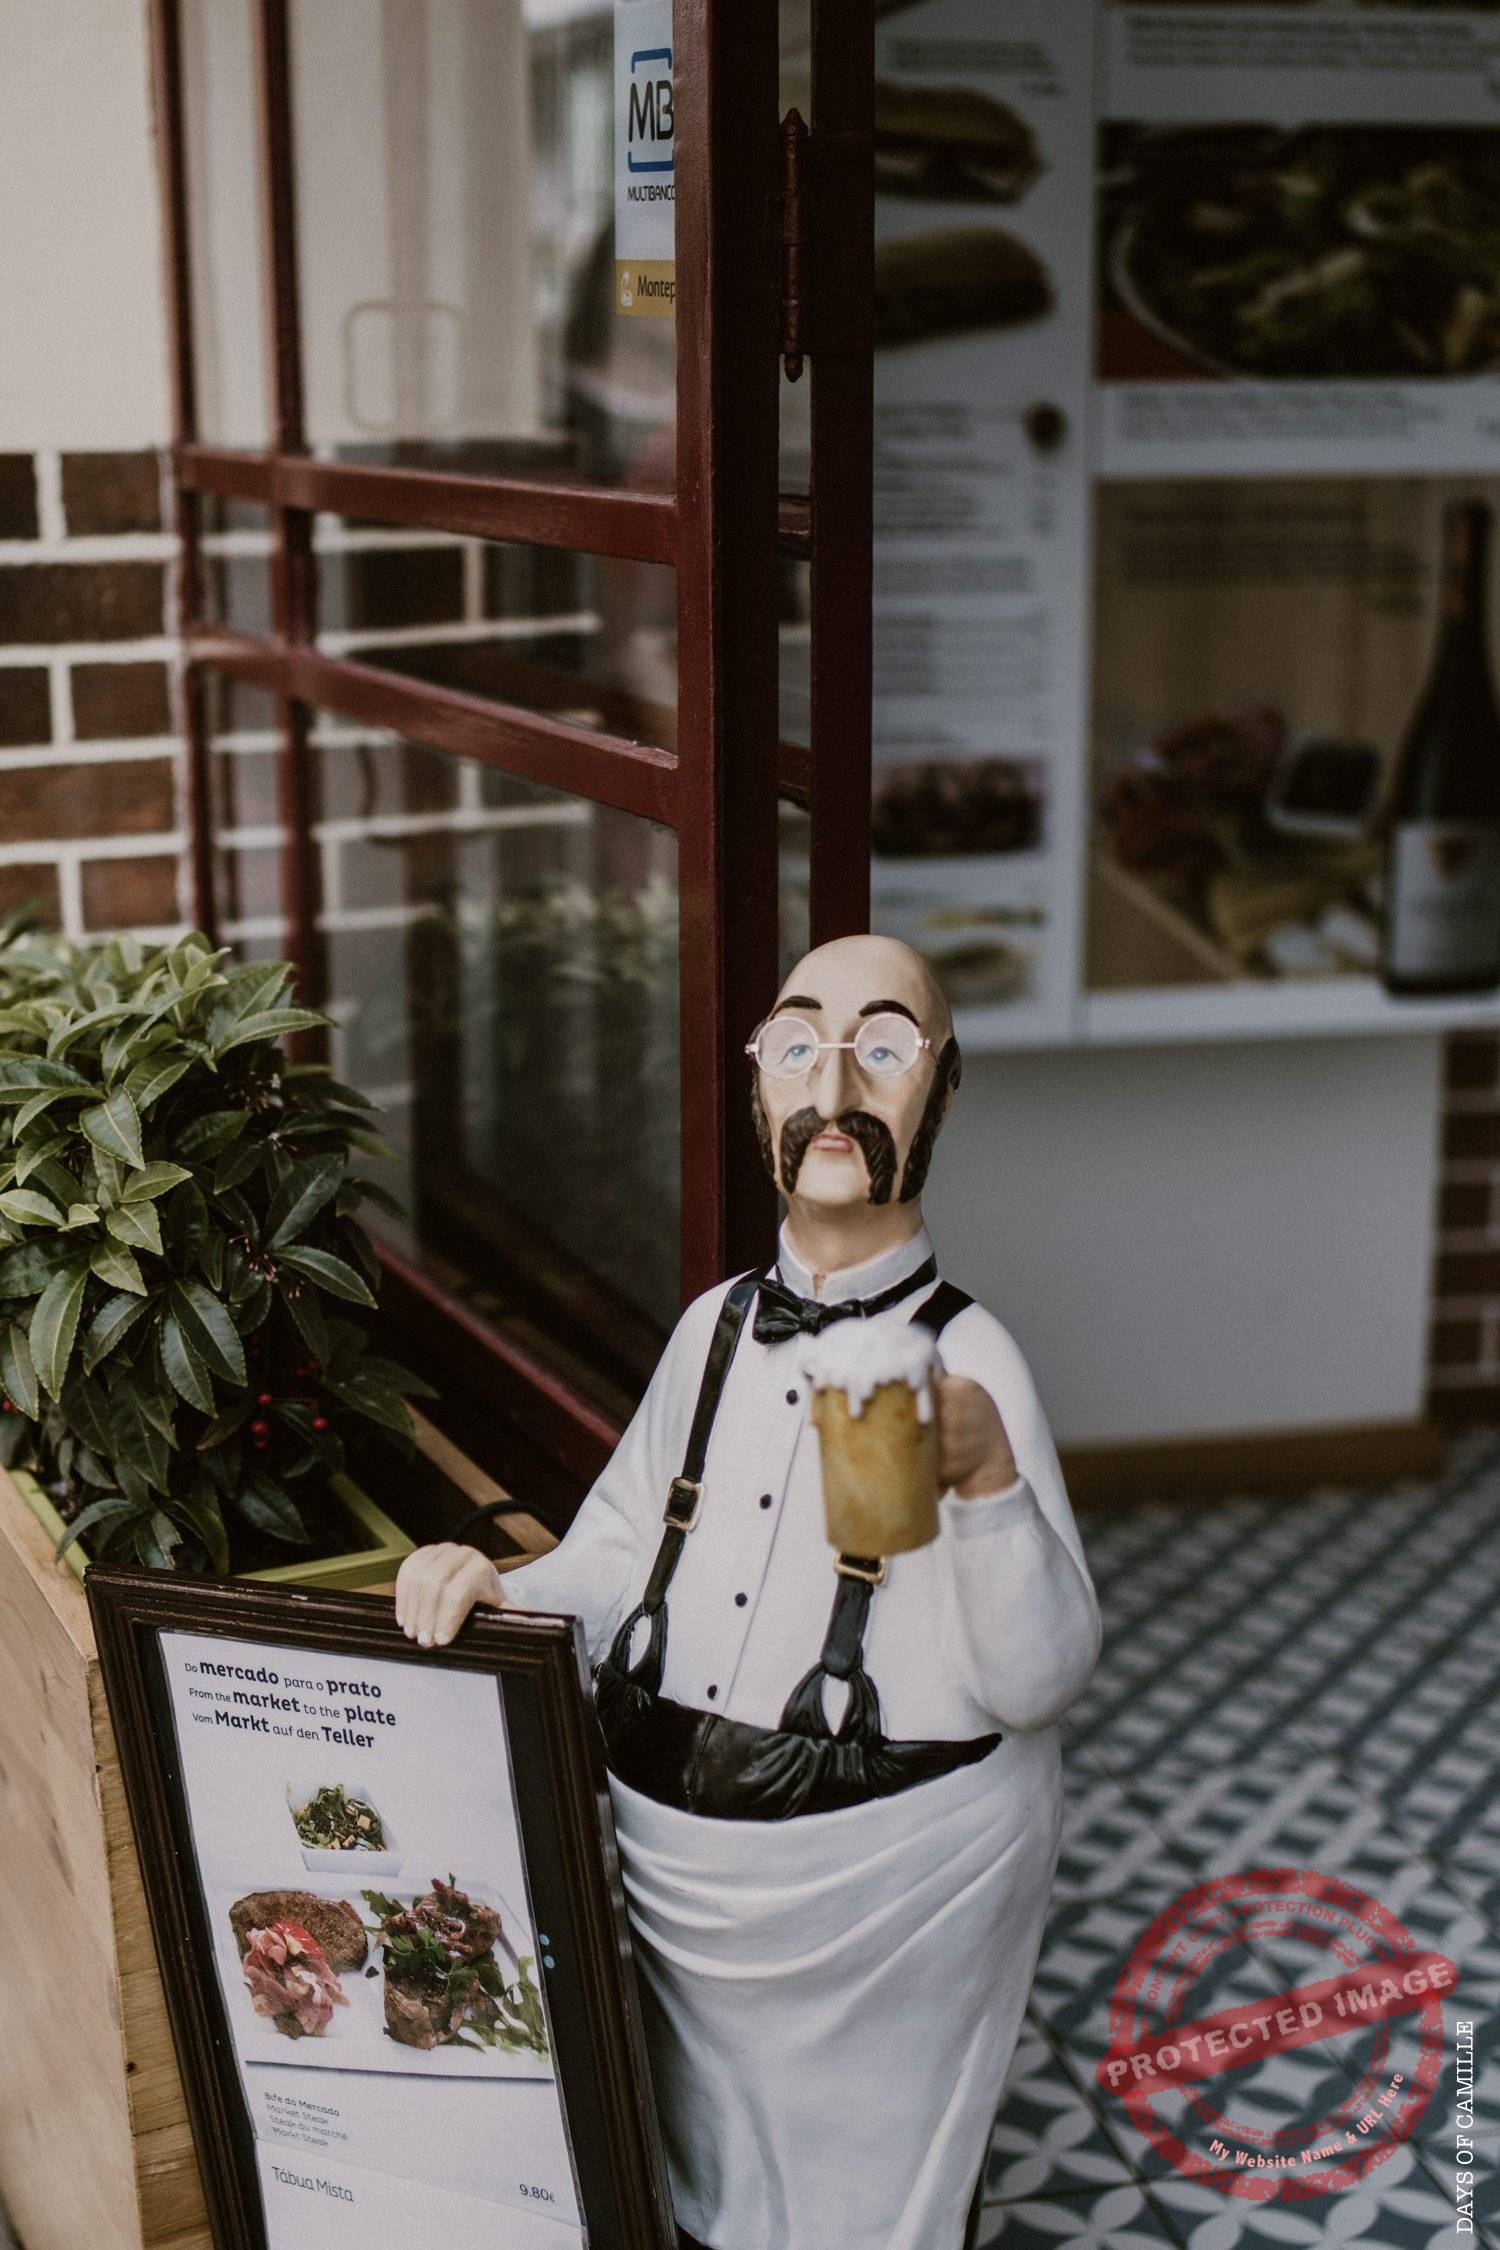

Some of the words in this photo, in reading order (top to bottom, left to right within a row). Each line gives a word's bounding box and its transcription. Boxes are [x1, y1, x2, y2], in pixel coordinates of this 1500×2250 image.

[628, 80, 674, 142] MB
[184, 1662, 198, 1673] Do
[199, 1661, 279, 1684] mercado
[283, 1676, 313, 1690] para
[316, 1681, 324, 1691] o
[326, 1678, 382, 1698] prato
[189, 1687, 214, 1700] From
[215, 1692, 231, 1703] the
[233, 1690, 301, 1713] market
[303, 1703, 317, 1715] to
[320, 1705, 341, 1718] the
[344, 1705, 397, 1726] plate
[192, 1712, 214, 1724] Vom
[214, 1710, 270, 1733] Markt
[272, 1724, 293, 1737] auf
[296, 1728, 320, 1741] den
[321, 1726, 375, 1748] Teller
[298, 2099, 339, 2117] Mercado
[271, 2166, 315, 2191] Tábua
[316, 2178, 354, 2202] Mista
